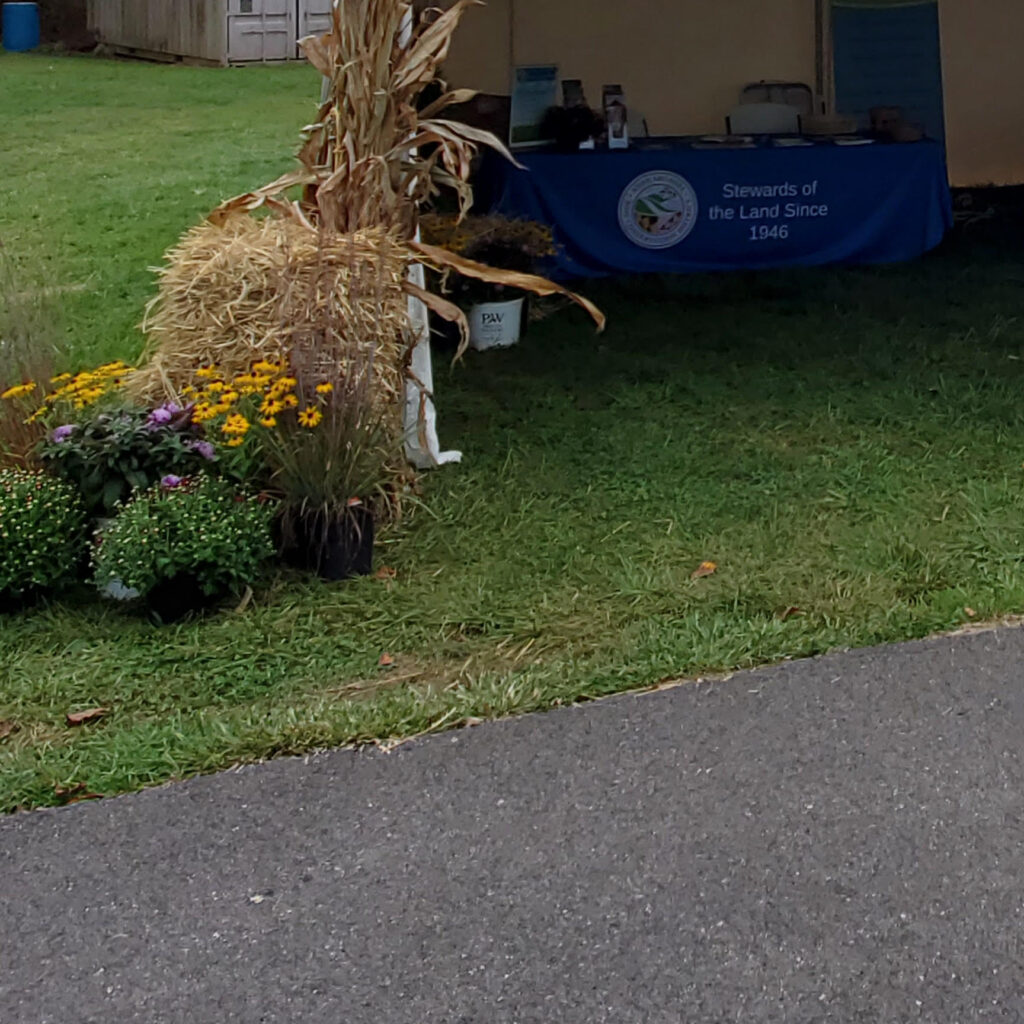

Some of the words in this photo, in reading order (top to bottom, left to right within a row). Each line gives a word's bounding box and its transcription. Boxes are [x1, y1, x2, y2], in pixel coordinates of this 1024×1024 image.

[722, 181, 798, 199] Stewards
[802, 180, 818, 196] of
[708, 205, 735, 220] the
[740, 204, 780, 220] Land
[784, 203, 828, 218] Since
[748, 224, 789, 241] 1946
